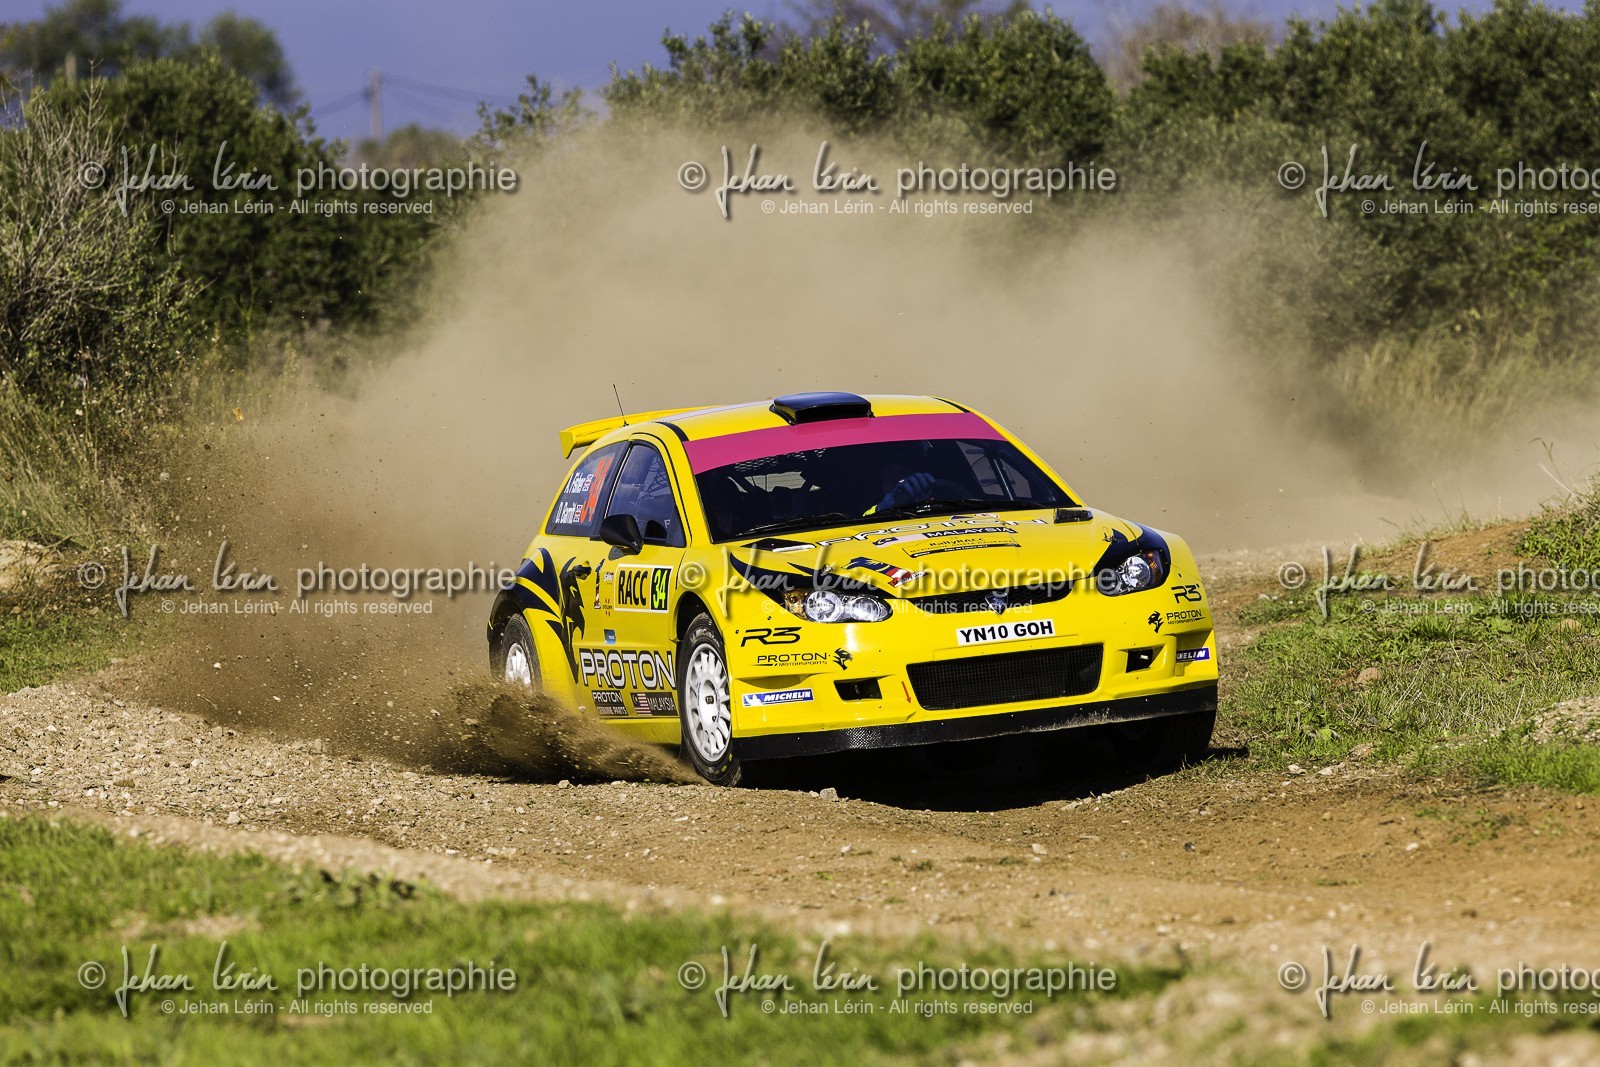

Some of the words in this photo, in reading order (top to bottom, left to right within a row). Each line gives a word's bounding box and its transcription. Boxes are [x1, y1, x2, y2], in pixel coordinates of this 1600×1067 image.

[926, 526, 1015, 538] MALAYSIA
[618, 570, 648, 606] RACC
[653, 569, 668, 609] 34
[1171, 584, 1202, 604] R3
[1166, 609, 1202, 620] PROTON
[741, 627, 802, 647] R3
[960, 625, 1008, 643] YN10
[1013, 620, 1054, 637] GOH
[757, 652, 827, 663] PROTON
[579, 648, 677, 690] PROTON
[592, 691, 623, 703] PROTON
[763, 691, 811, 702] MICHELIN
